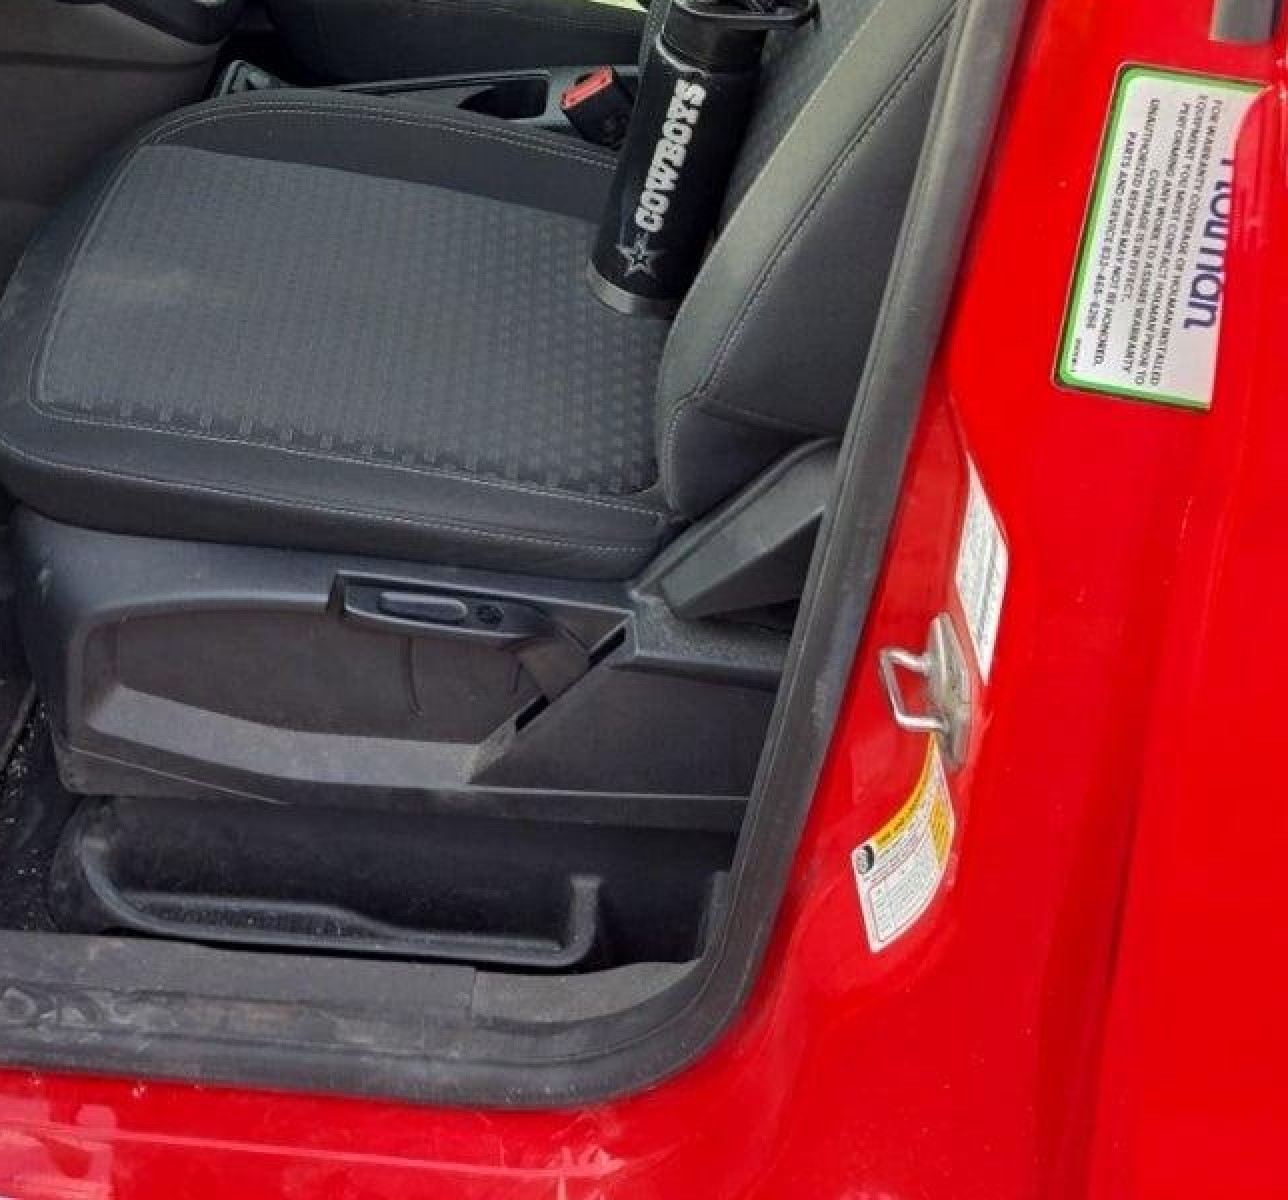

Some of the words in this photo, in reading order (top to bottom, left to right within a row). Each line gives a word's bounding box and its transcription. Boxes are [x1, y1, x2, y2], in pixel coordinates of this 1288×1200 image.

[635, 79, 707, 233] COWBOYS
[1192, 124, 1217, 192] WARRANTY
[1136, 169, 1159, 230] COVERAGE
[1178, 193, 1201, 256] COVERAGE
[1145, 281, 1166, 331] HOLMAN
[1162, 275, 1183, 325] HOLMAN
[1120, 307, 1145, 373] WARRANTY
